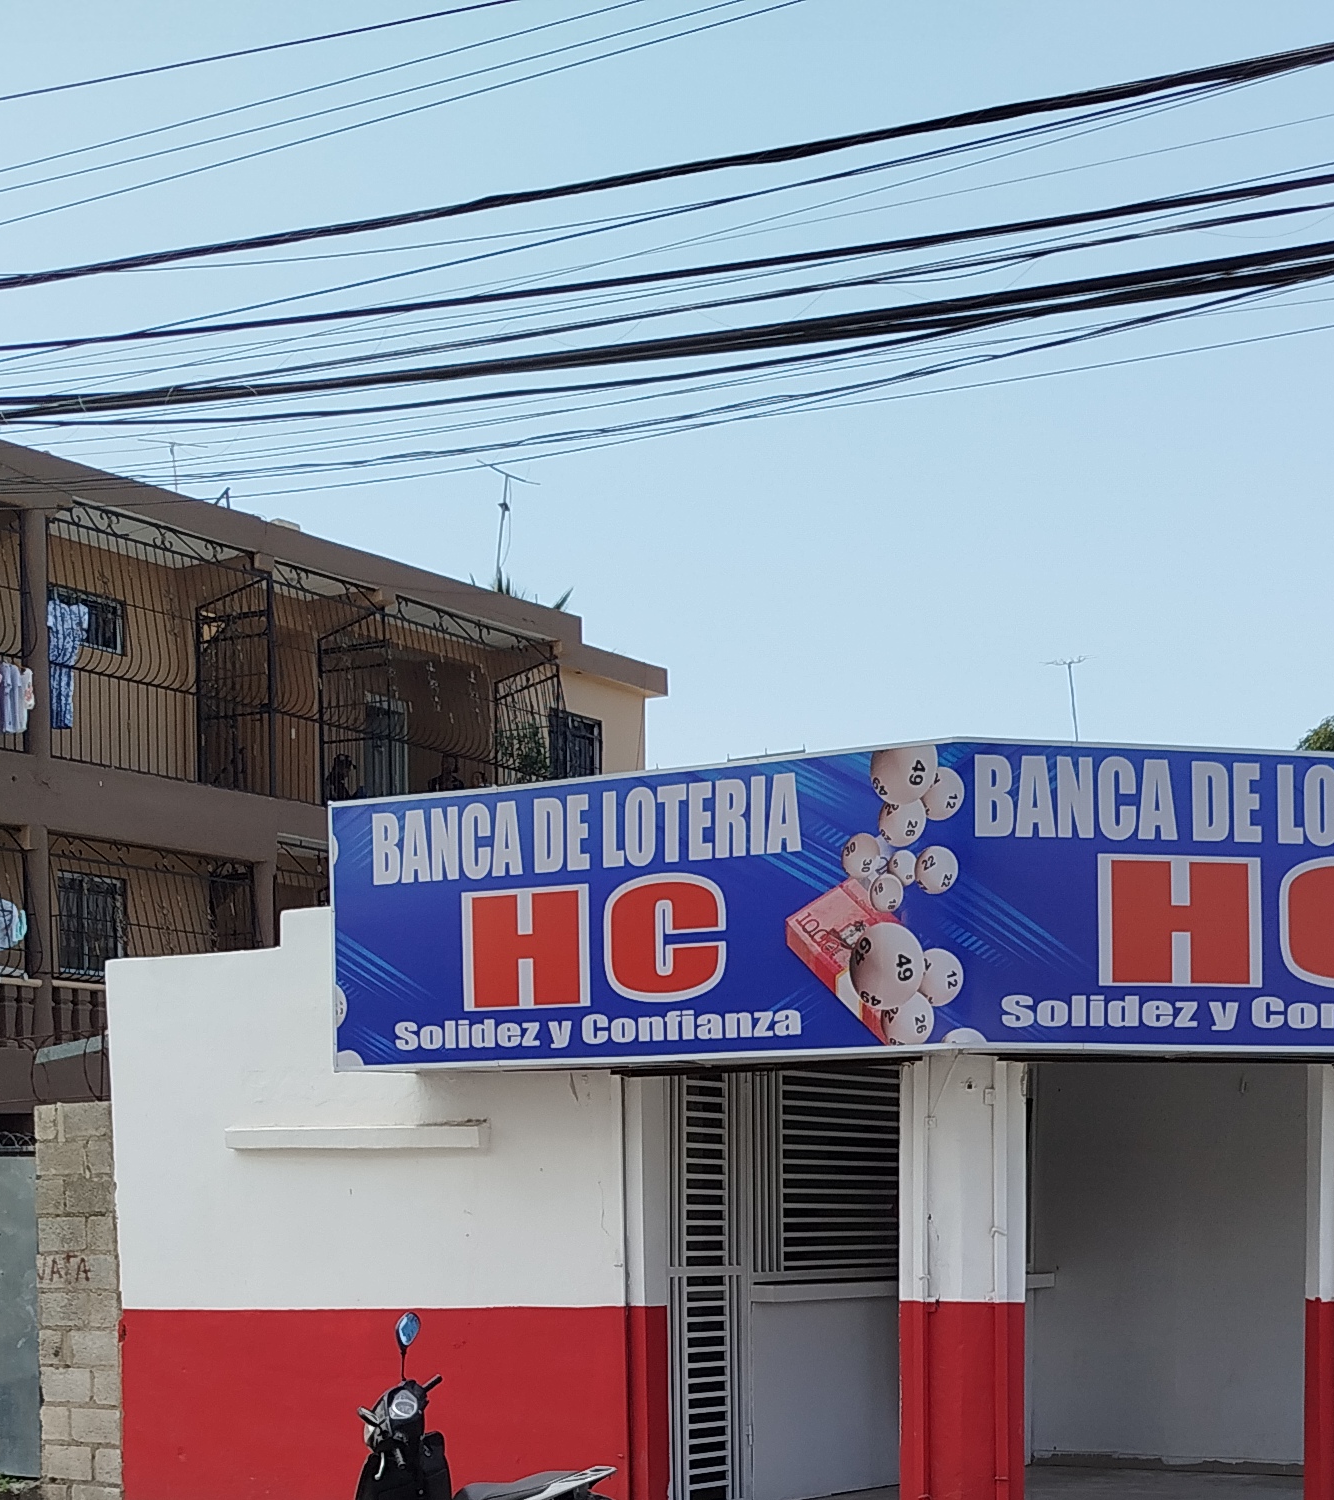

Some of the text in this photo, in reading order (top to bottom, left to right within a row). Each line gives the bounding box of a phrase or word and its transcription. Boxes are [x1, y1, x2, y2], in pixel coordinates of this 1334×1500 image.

[908, 759, 926, 786] 49
[945, 793, 959, 810] 12
[973, 754, 1179, 841] BANCA
[1191, 761, 1263, 842] DE
[371, 772, 803, 886] BANCA DE LOTERIA
[905, 819, 918, 838] 26
[843, 841, 857, 857] 30
[861, 858, 873, 873] 30
[921, 855, 937, 871] 22
[461, 872, 727, 1011] HC
[895, 953, 914, 982] 49
[946, 970, 959, 989] 12
[914, 1014, 927, 1034] 26
[1001, 993, 1200, 1030] Solidez
[1209, 1002, 1243, 1032] y
[394, 1009, 802, 1051] Solidez y Confianza
